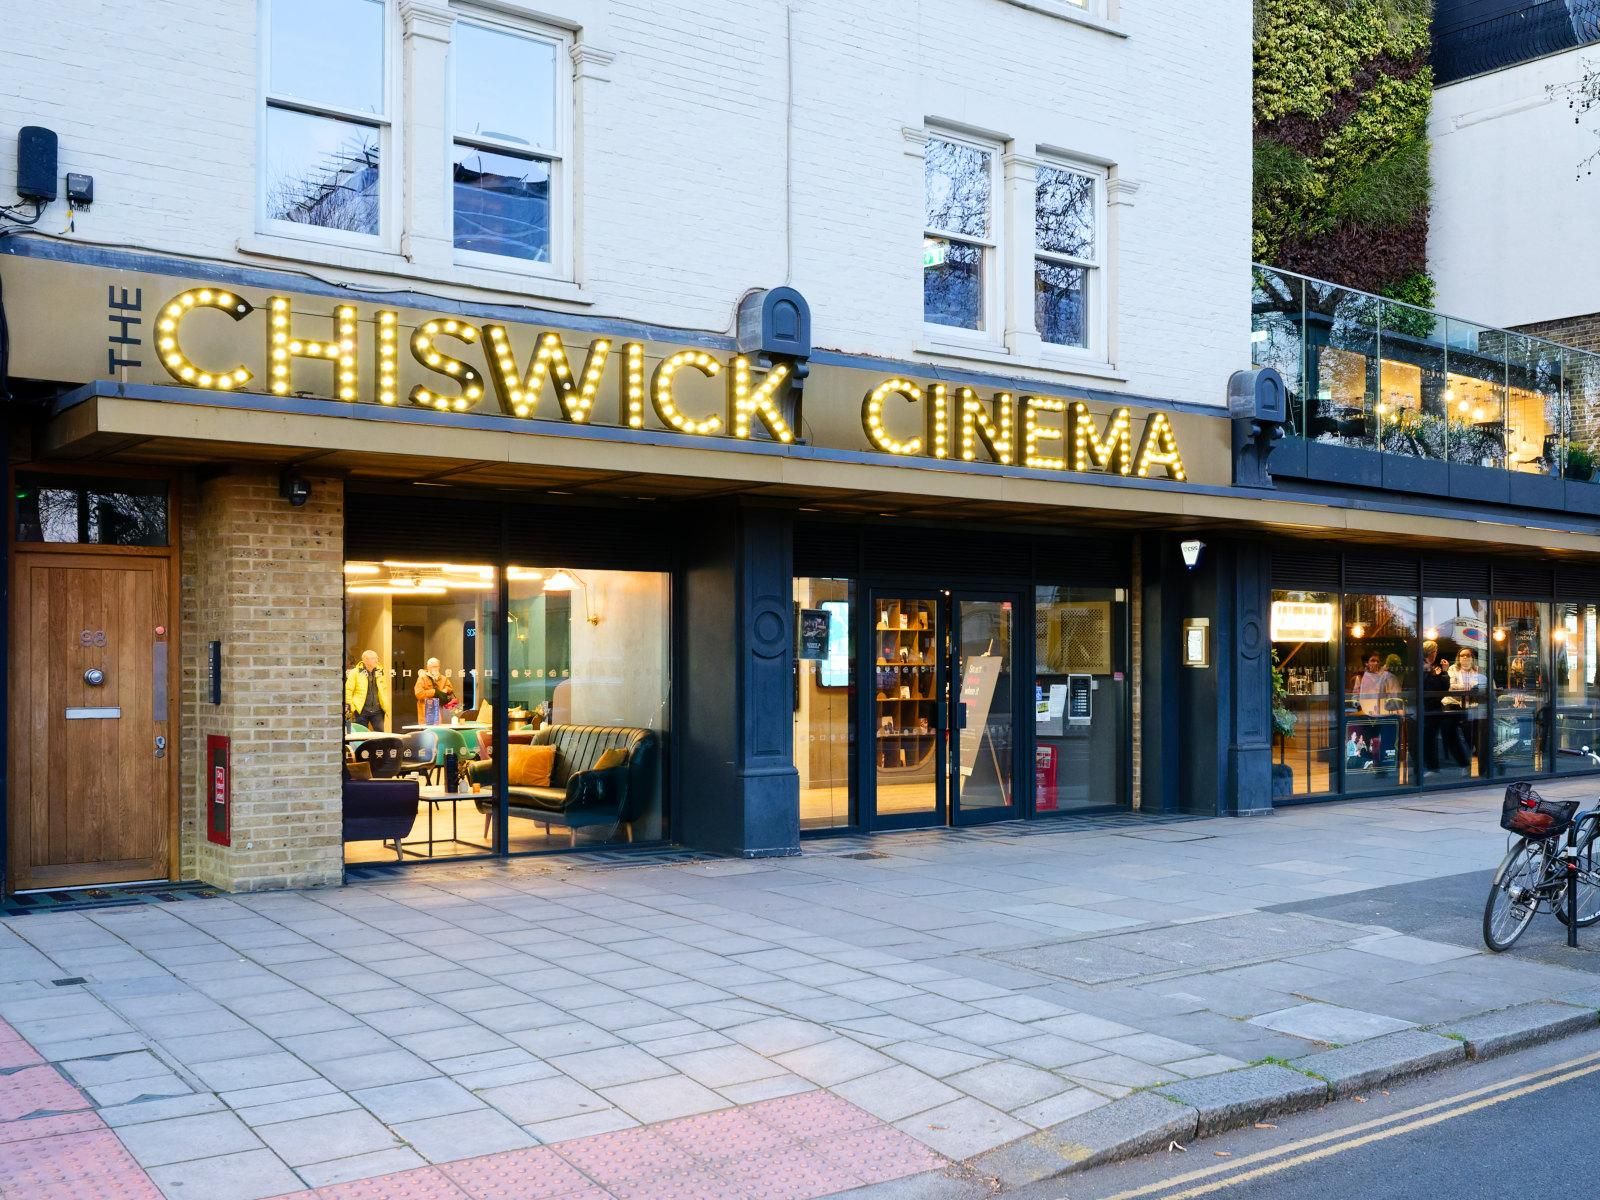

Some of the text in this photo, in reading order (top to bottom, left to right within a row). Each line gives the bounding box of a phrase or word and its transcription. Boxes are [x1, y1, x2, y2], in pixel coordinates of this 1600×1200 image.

[108, 284, 142, 374] THE
[153, 286, 1188, 482] CHISWICK CINEMA
[80, 630, 107, 647] 98
